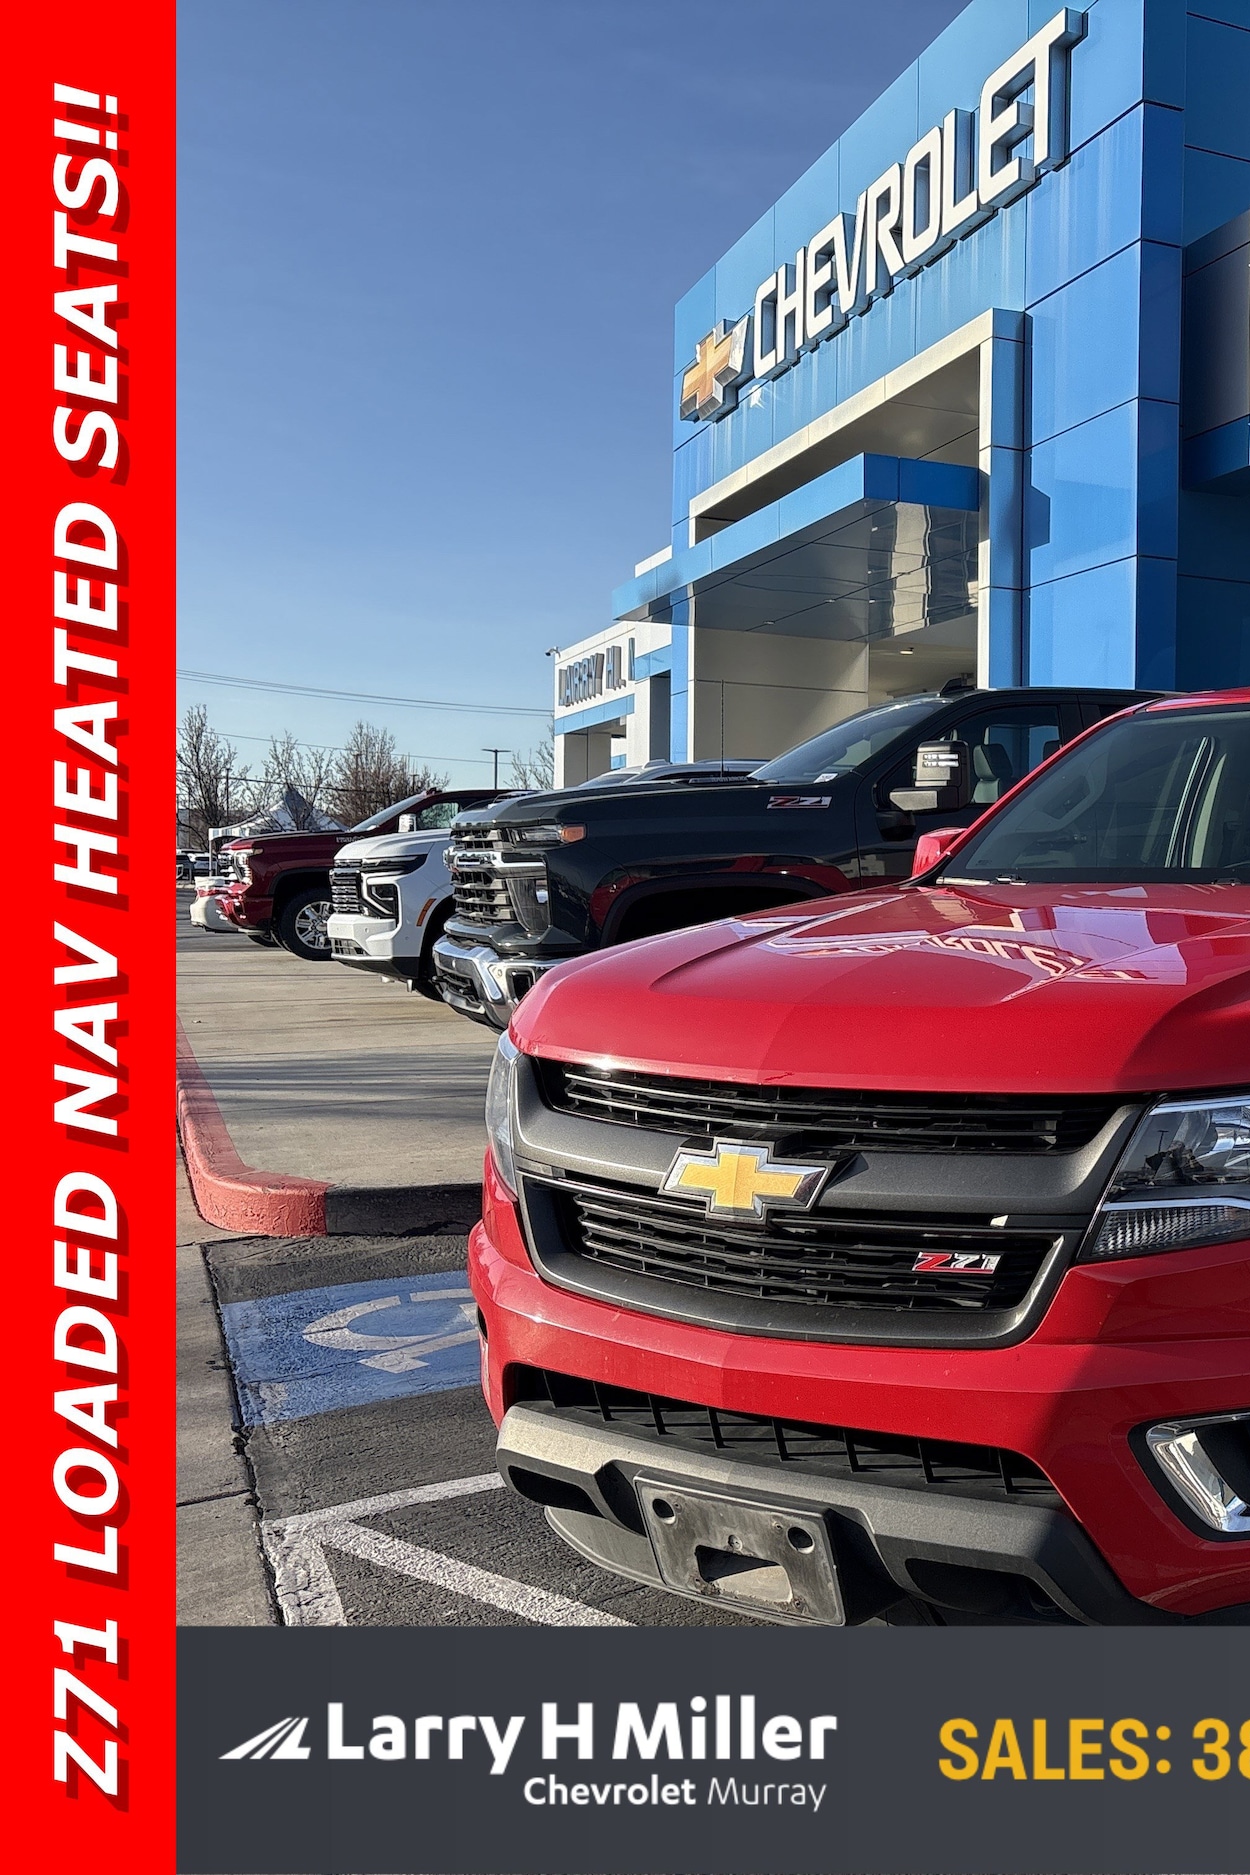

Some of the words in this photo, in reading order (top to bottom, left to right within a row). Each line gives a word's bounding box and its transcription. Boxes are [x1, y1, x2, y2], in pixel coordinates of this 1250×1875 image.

[753, 7, 1084, 380] CHEVROLET
[767, 796, 832, 809] Z71
[912, 1252, 1001, 1274] Z71
